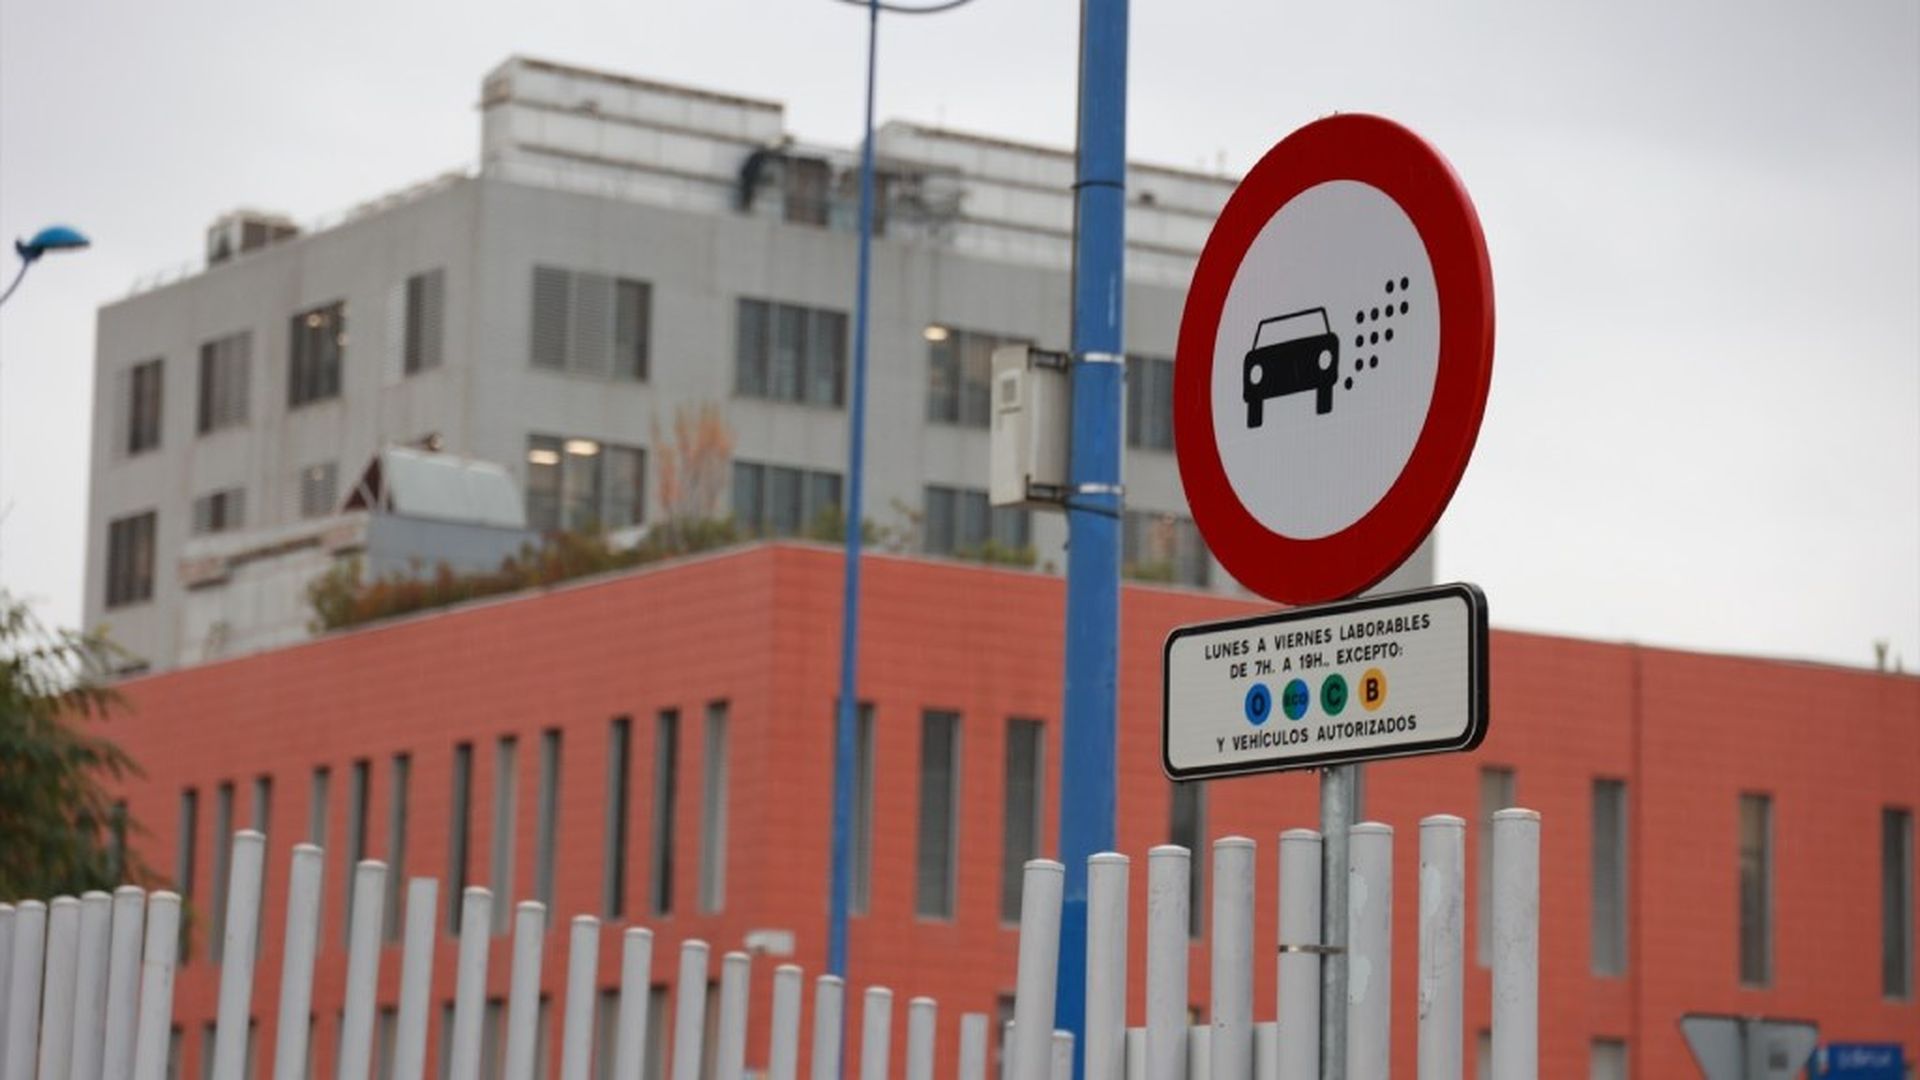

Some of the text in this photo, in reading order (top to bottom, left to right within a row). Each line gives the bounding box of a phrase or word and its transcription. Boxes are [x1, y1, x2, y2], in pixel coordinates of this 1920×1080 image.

[1205, 614, 1431, 660] LUNES A VIERNES LABORABLES
[1230, 662, 1247, 678] DE
[1282, 656, 1292, 670] A
[1336, 642, 1403, 664] EXCEPTO:
[1326, 683, 1341, 706] C
[1366, 678, 1379, 702] B
[1217, 715, 1416, 752] Y VEHÍCULOS AUTORIZADOS
